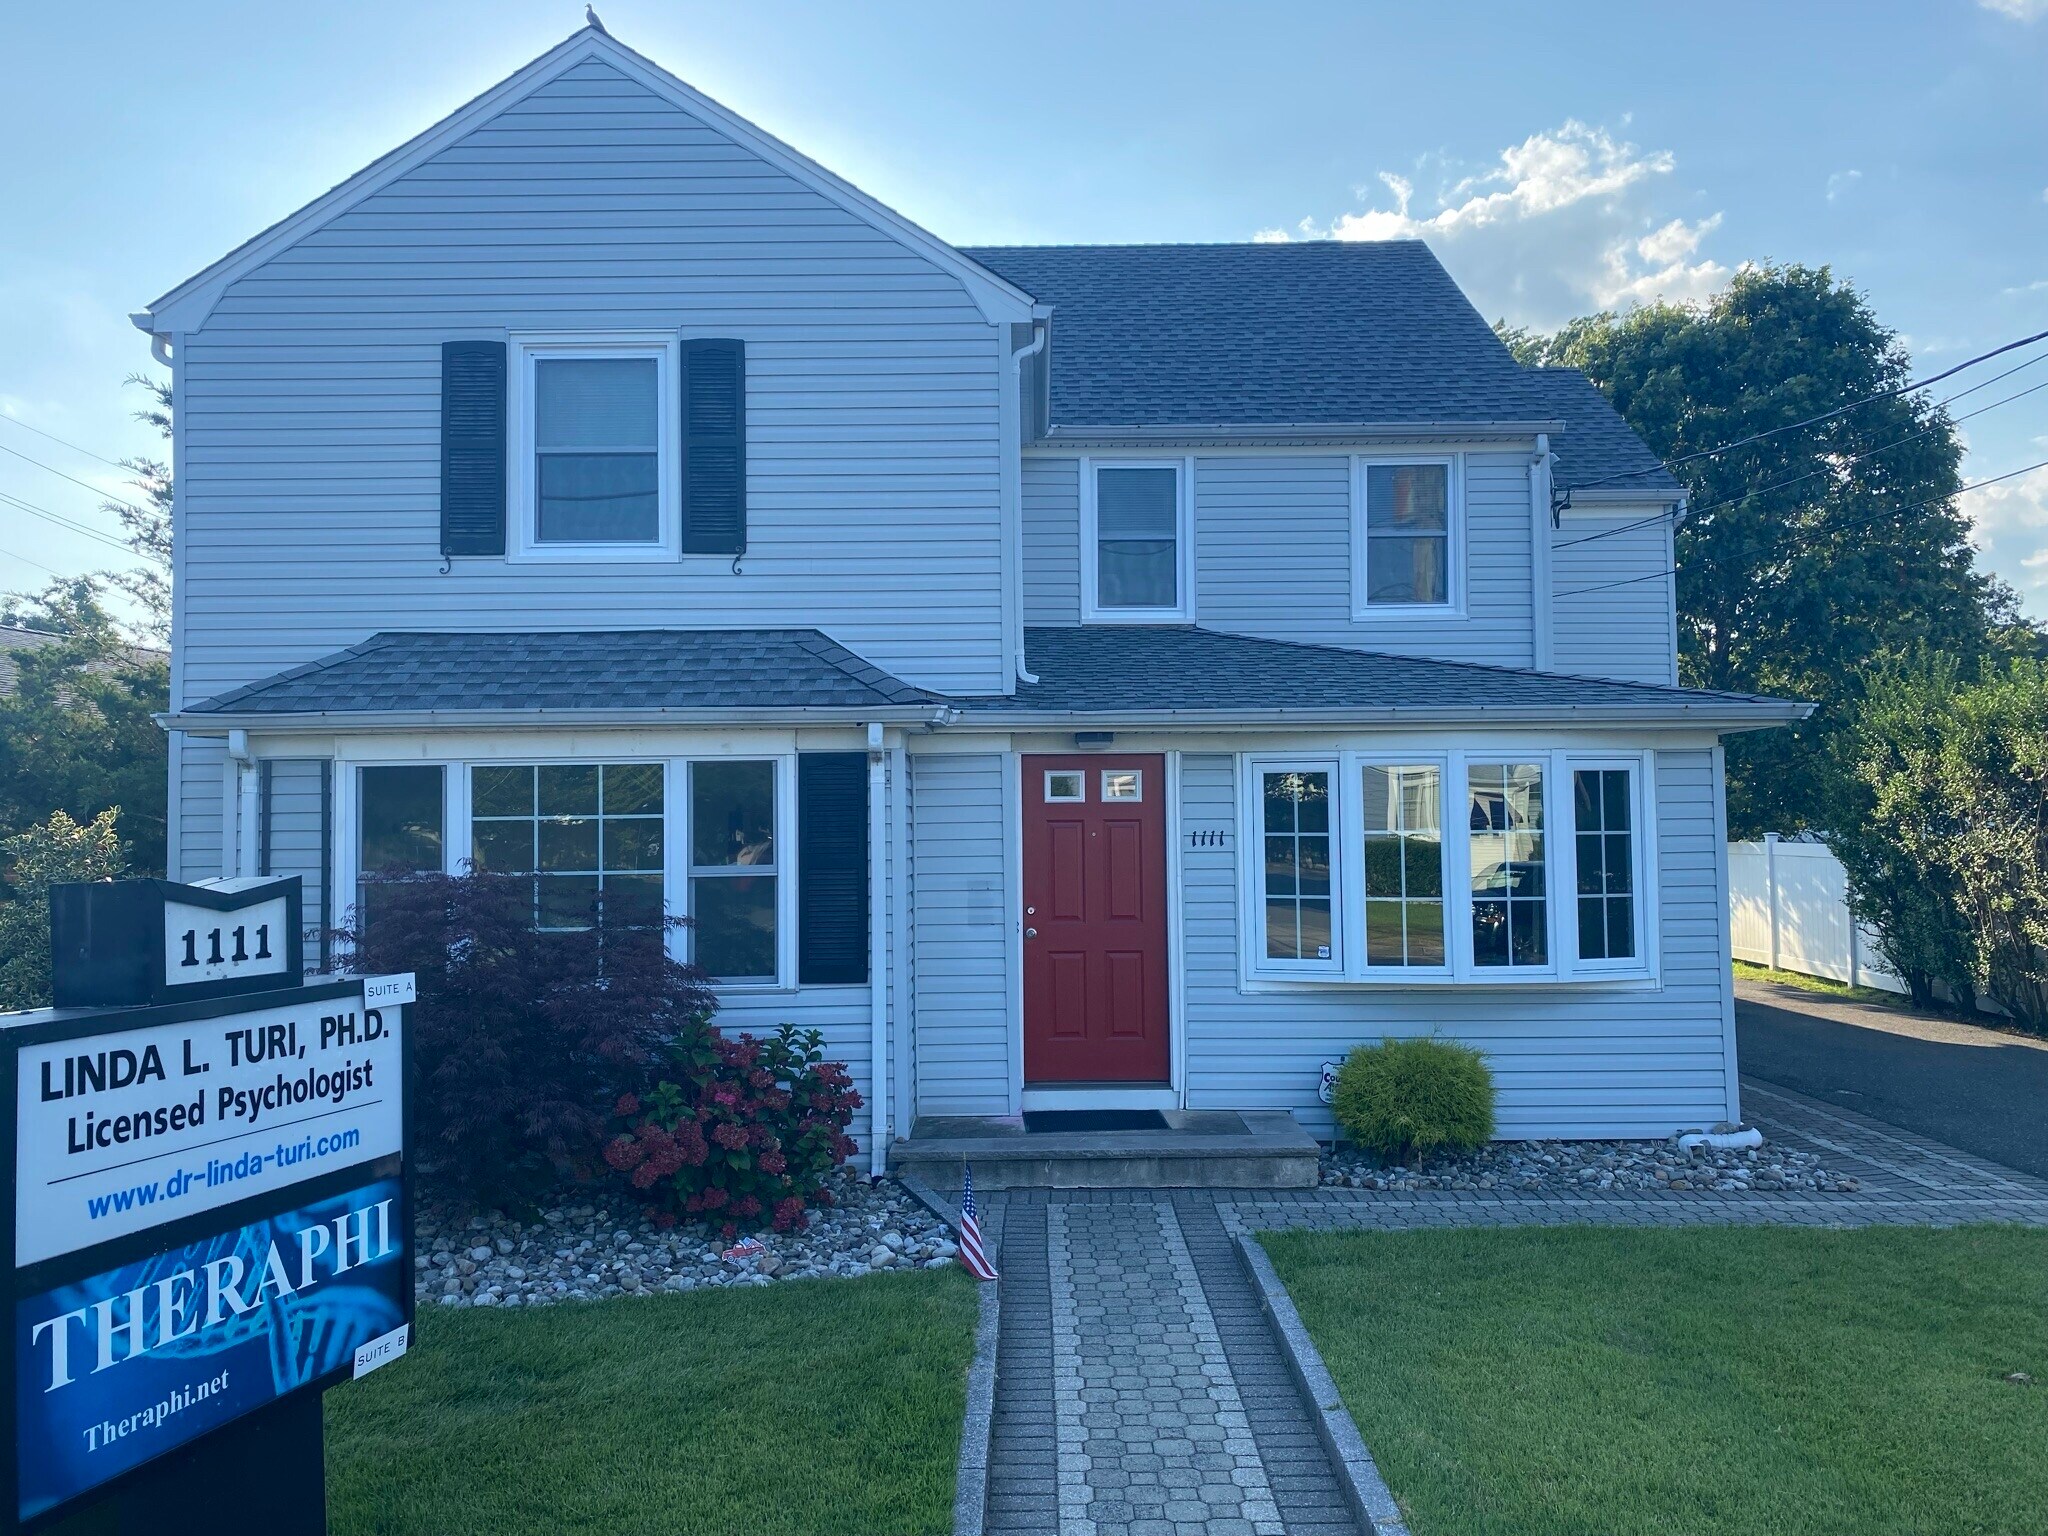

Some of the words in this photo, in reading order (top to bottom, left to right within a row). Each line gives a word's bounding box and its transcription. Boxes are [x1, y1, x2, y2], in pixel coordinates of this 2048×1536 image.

[1192, 830, 1224, 847] 1111
[181, 924, 272, 967] 1111
[368, 983, 399, 997] SUITE
[405, 981, 413, 992] A
[41, 1044, 166, 1102] LINDA
[183, 1038, 210, 1077] L.
[225, 1021, 306, 1067] TURI,
[320, 1009, 390, 1051] PH.D.
[68, 1089, 205, 1155] Licensed
[218, 1057, 374, 1124] Psychologist
[88, 1126, 360, 1220] www.dr-linda-turi.com
[32, 1198, 394, 1394] THERAPHI
[357, 1341, 391, 1367] SUITE
[397, 1335, 405, 1347] B
[83, 1369, 229, 1454] Theraphi.net
